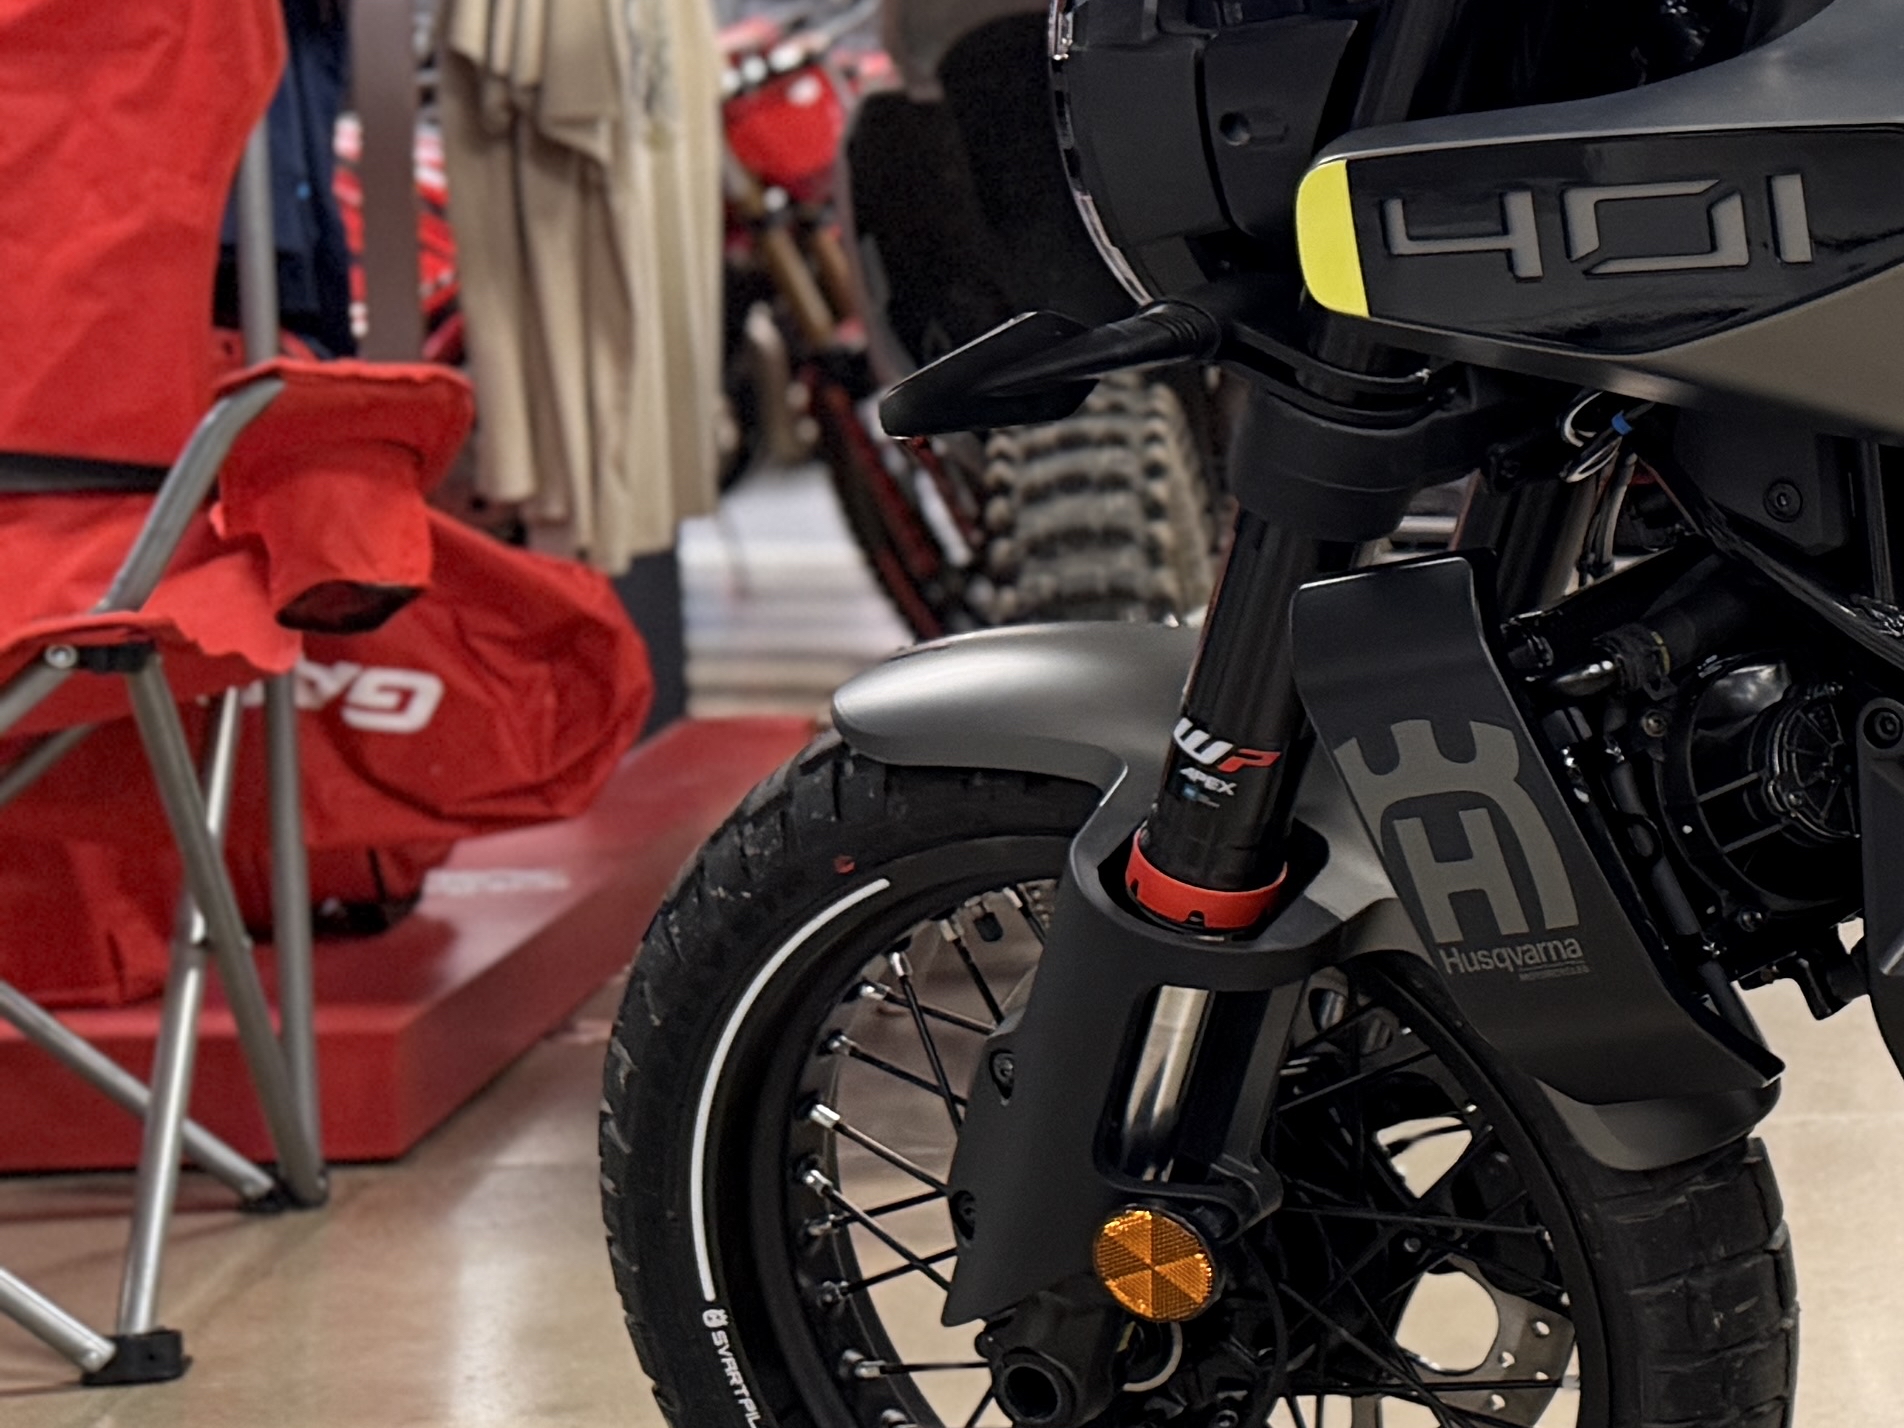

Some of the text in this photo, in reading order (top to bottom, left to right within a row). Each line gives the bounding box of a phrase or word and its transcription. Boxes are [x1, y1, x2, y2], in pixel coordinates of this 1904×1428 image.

[1381, 173, 1813, 280] 401
[1173, 717, 1281, 772] WP
[1180, 767, 1237, 796] APEX
[1440, 937, 1584, 975] Husqvarna
